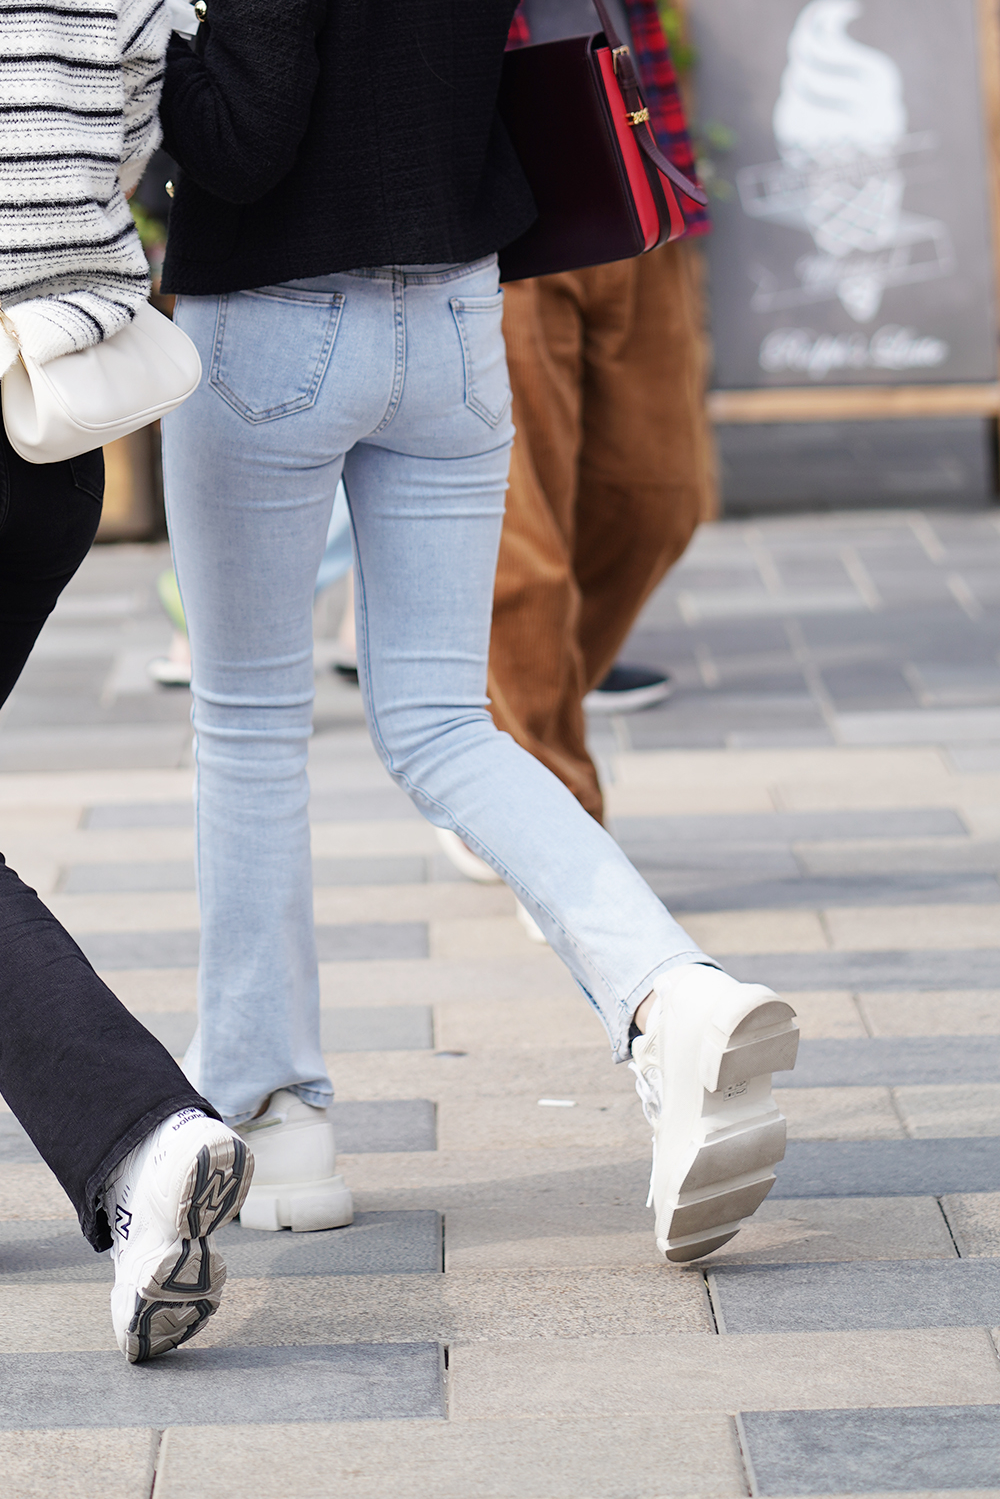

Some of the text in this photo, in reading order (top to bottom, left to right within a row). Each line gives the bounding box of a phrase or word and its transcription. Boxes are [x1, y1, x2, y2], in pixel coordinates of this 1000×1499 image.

[172, 1113, 207, 1131] balanc
[177, 1107, 197, 1119] new
[115, 1204, 132, 1241] N
